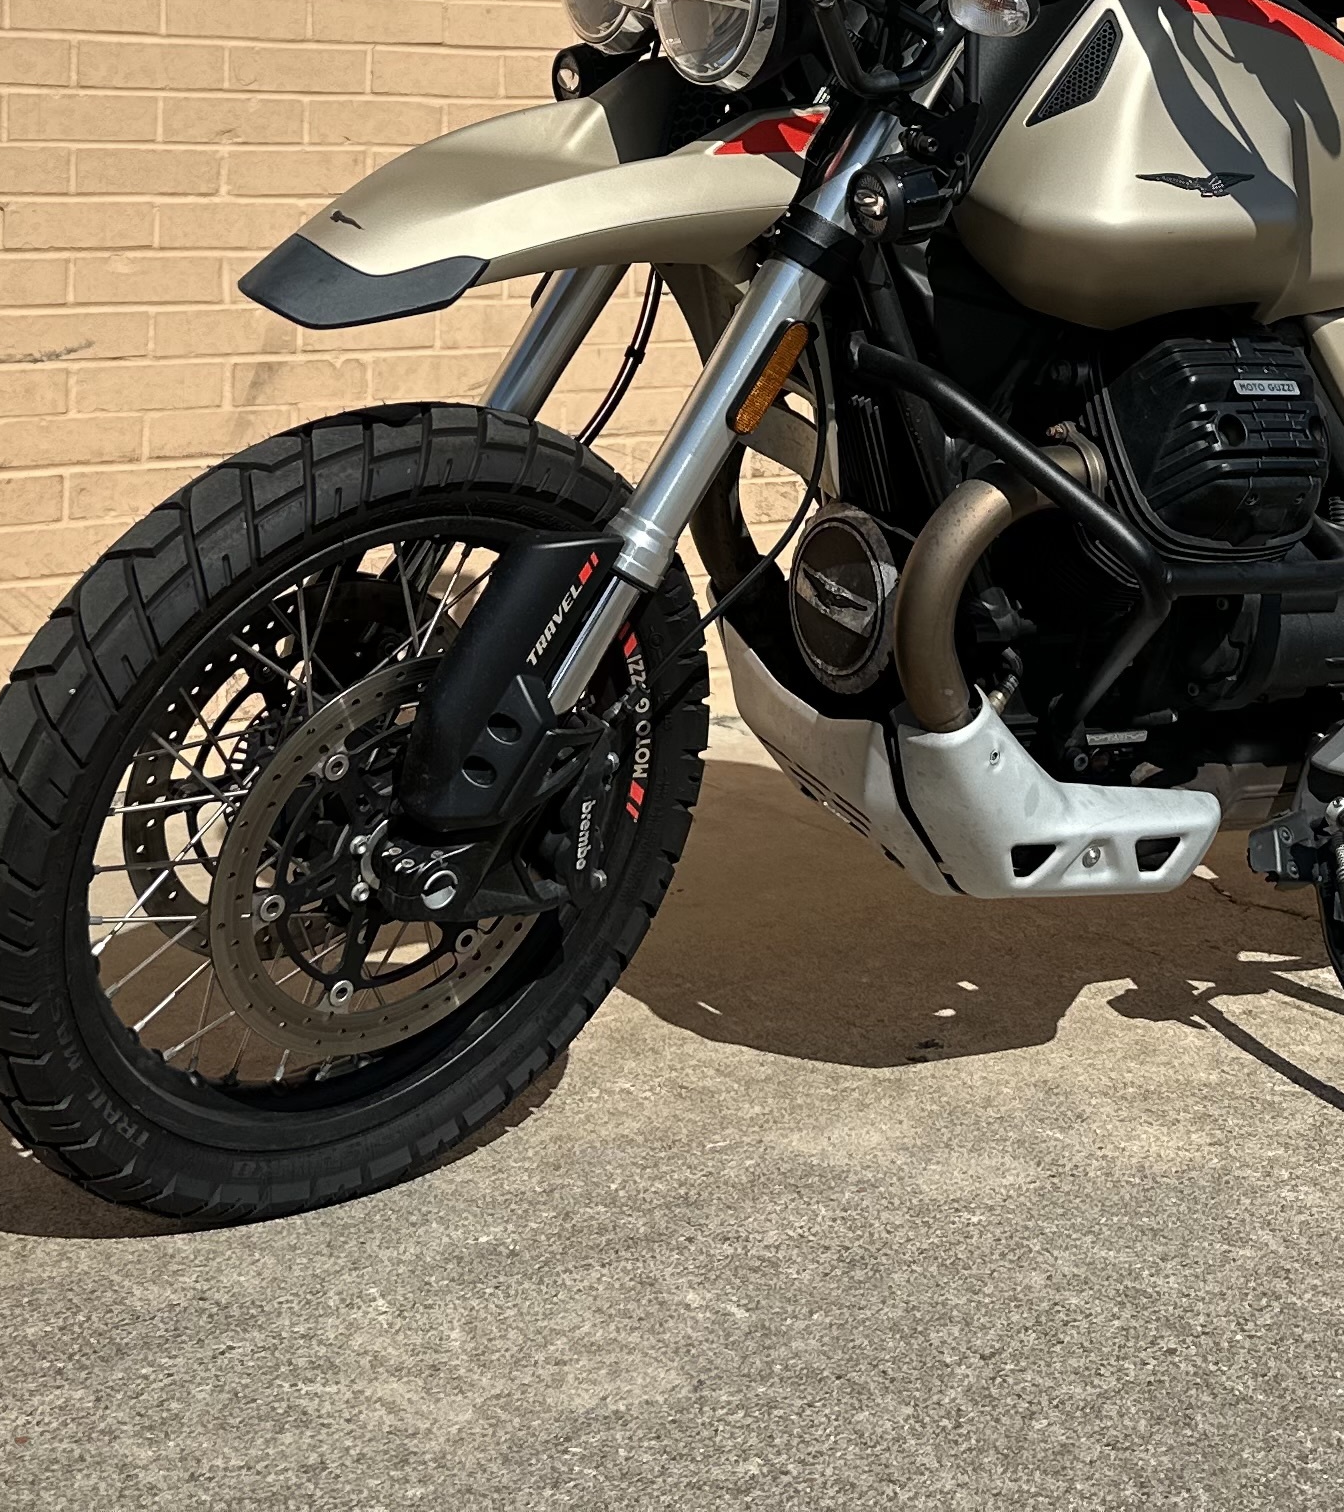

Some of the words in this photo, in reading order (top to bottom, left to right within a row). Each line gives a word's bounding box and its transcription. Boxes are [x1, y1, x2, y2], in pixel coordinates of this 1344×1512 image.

[1238, 382, 1266, 393] MOTO
[1267, 382, 1296, 393] GUZZI
[525, 584, 584, 666] TRAVEL
[626, 654, 651, 714] GZZI
[632, 719, 652, 779] MOTO
[575, 799, 597, 871] brembo
